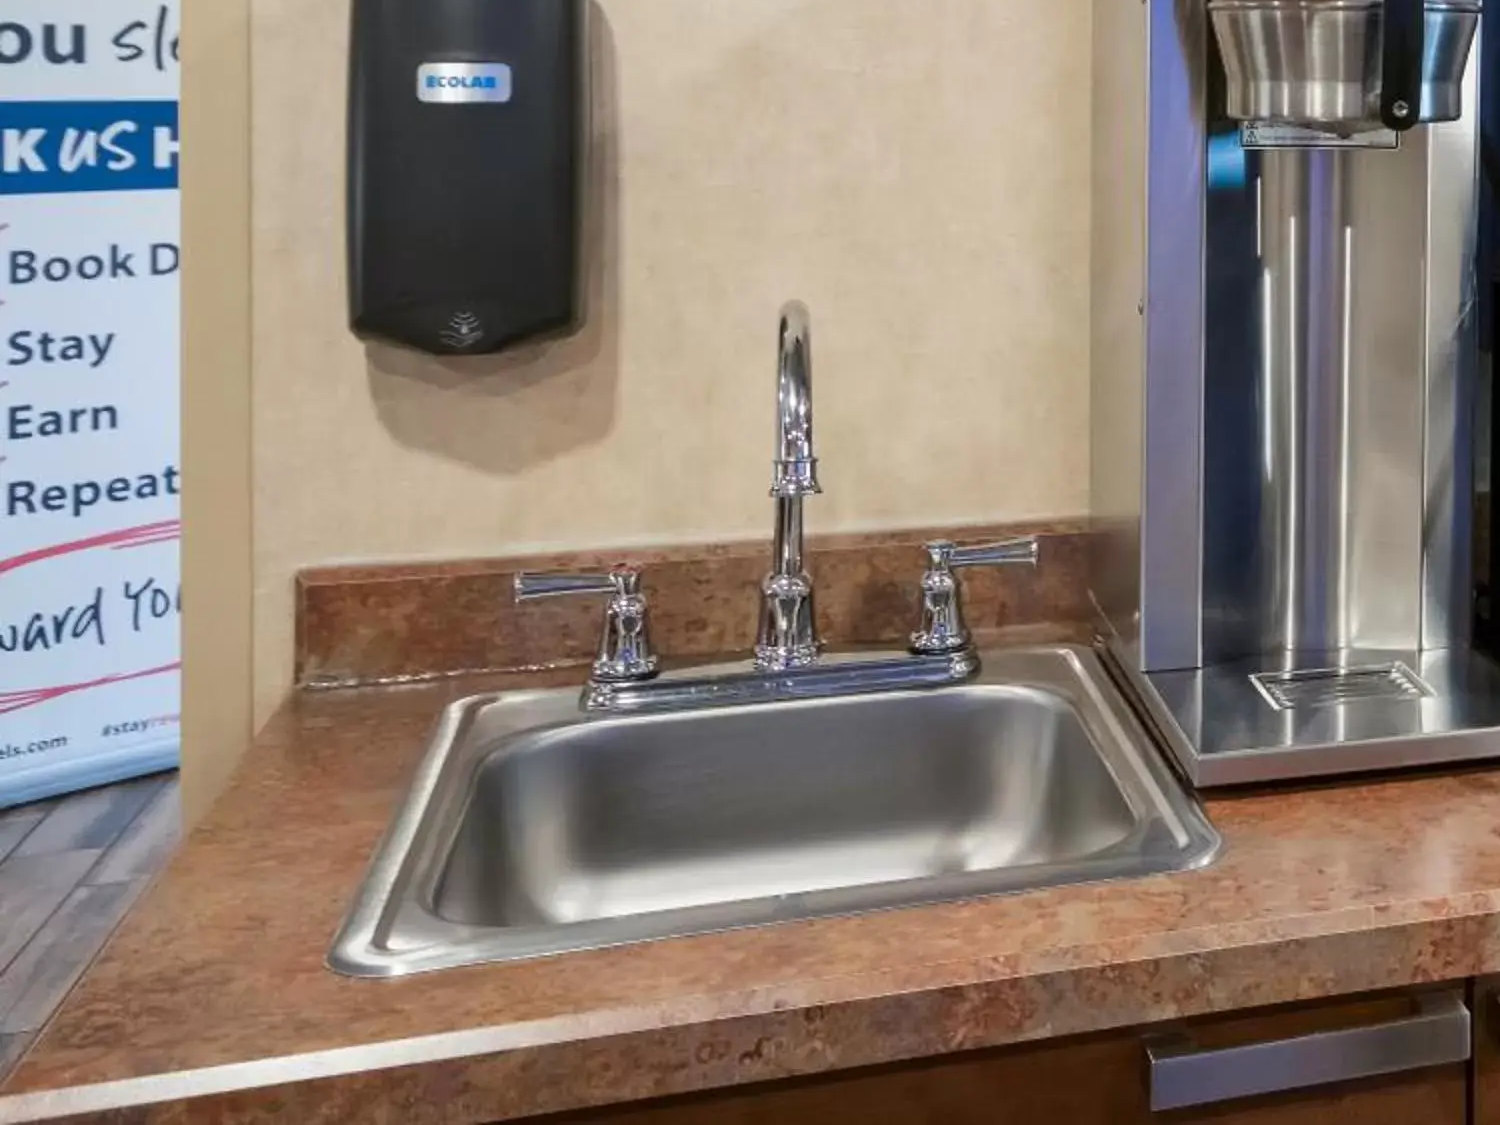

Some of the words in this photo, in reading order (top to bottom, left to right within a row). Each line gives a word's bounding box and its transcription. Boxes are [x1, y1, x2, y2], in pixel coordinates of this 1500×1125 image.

[0, 22, 86, 65] ou
[112, 5, 180, 71] sl
[425, 75, 497, 90] ECOLAB
[9, 244, 137, 284] Book
[7, 330, 116, 369] Stay
[8, 405, 119, 440] Earn
[8, 465, 179, 517] Repeat
[0, 586, 105, 652] ward
[124, 577, 182, 632] Yo
